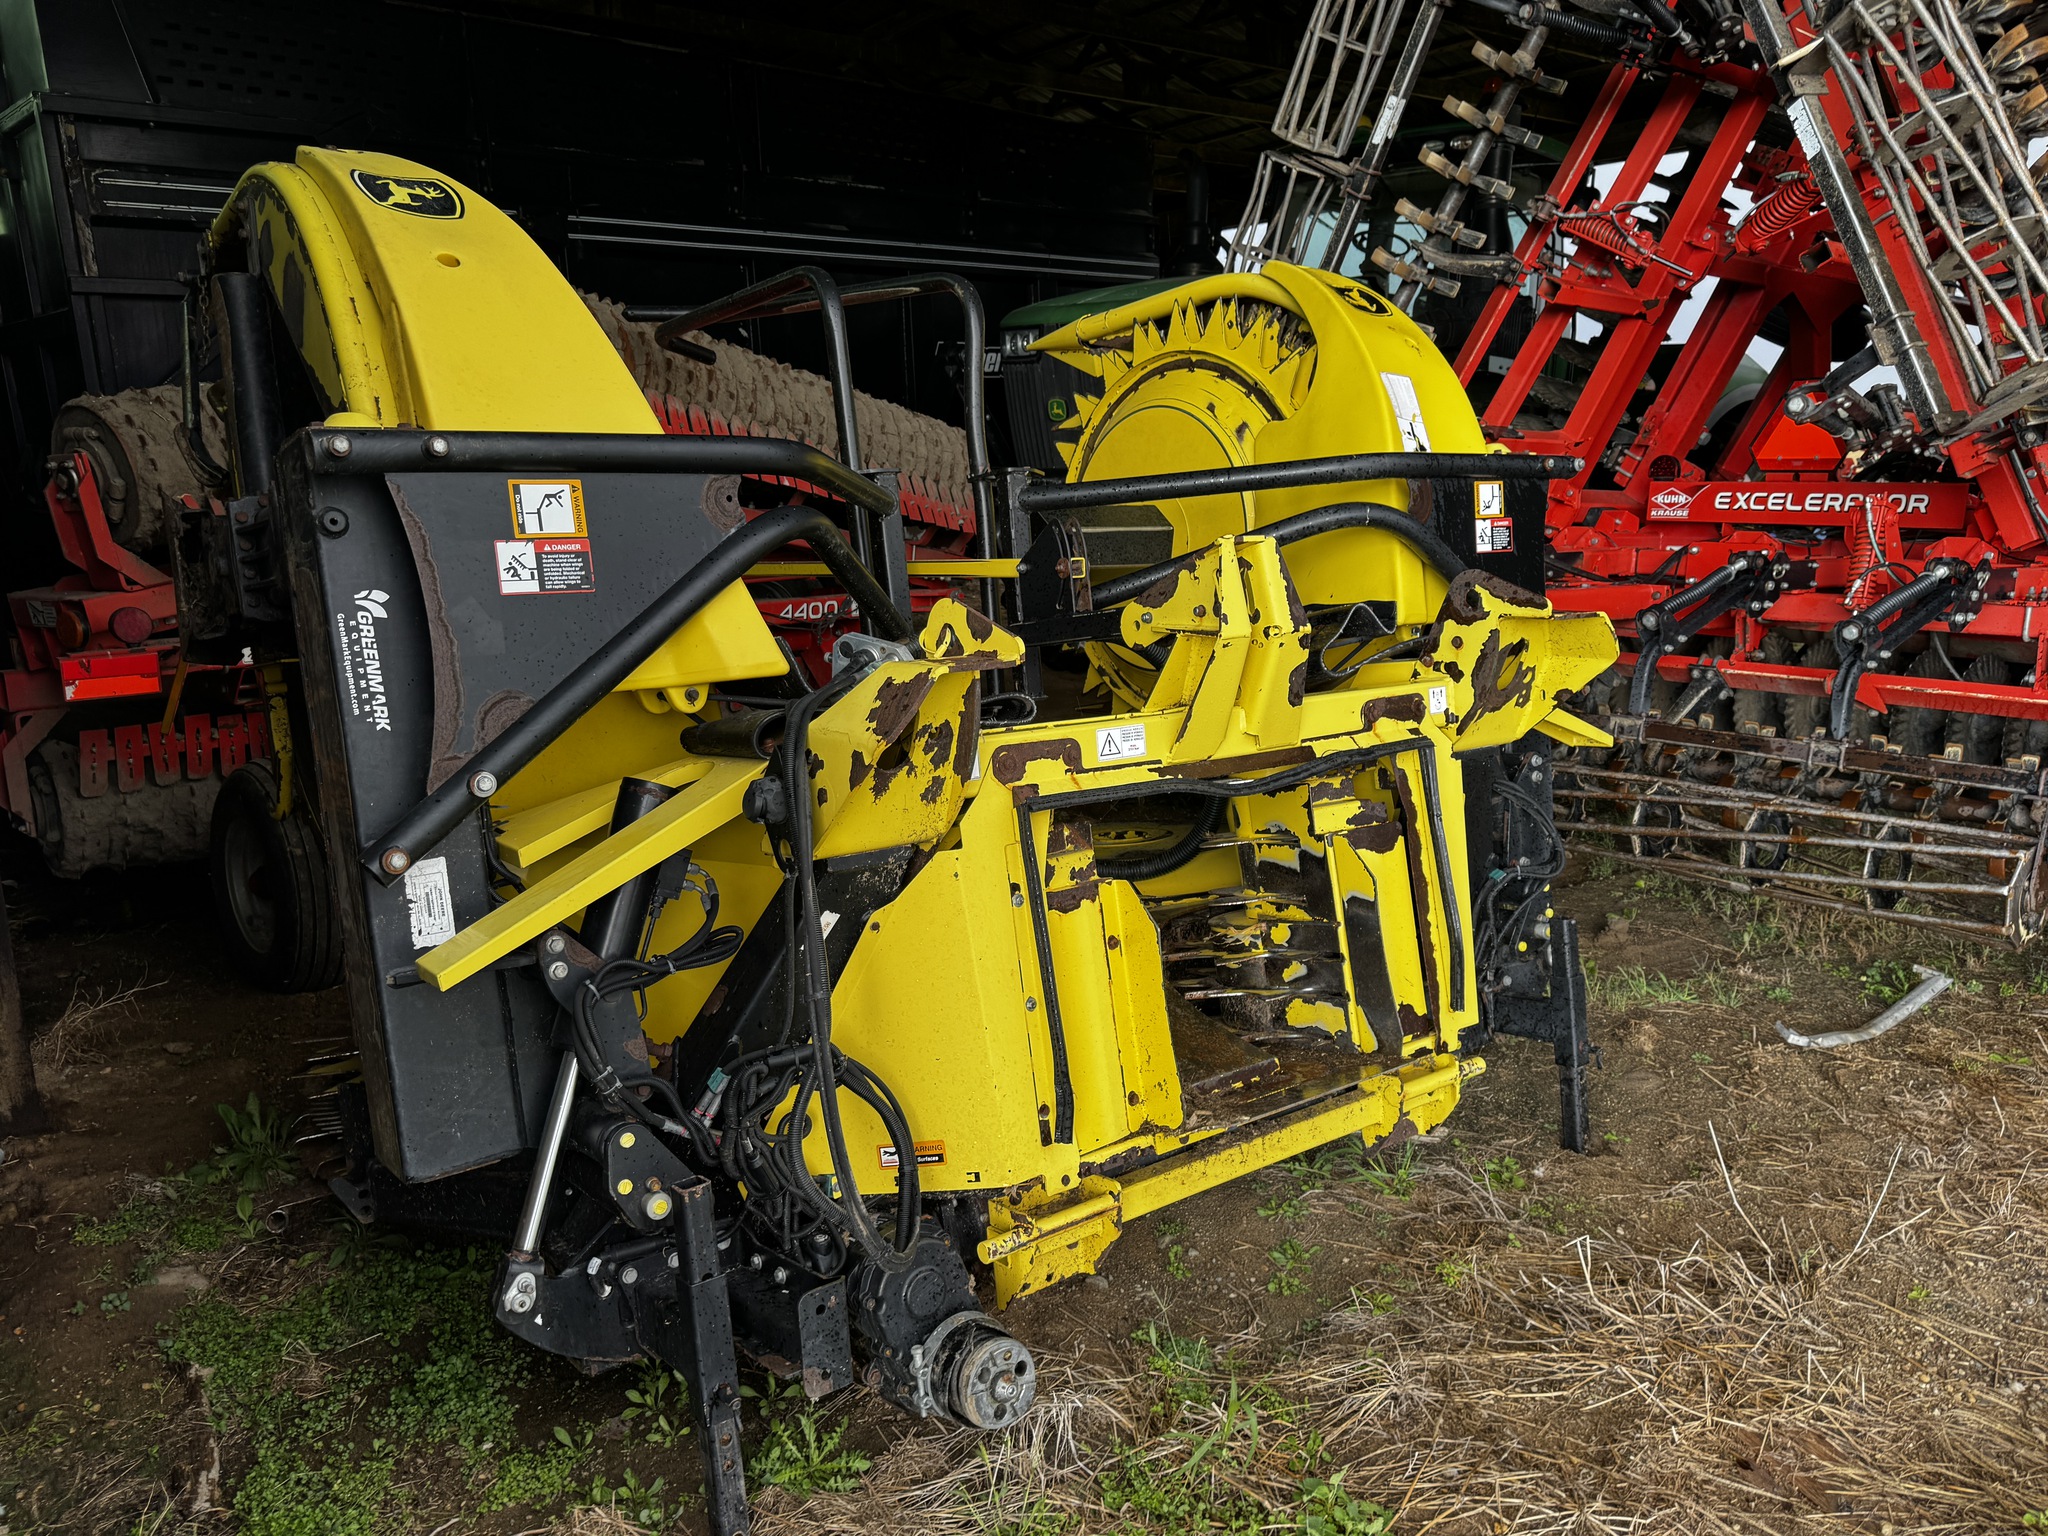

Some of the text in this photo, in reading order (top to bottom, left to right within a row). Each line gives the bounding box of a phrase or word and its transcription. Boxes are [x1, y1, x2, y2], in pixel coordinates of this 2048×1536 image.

[515, 494, 520, 502] Do
[1658, 495, 1686, 503] KUHN
[1714, 492, 1930, 514] EXCELERAOR
[574, 496, 584, 533] WARNING
[780, 601, 838, 620] 4400
[337, 613, 360, 716] GreenMarkEquipment.com
[350, 620, 373, 723] EQUIPMENT
[357, 611, 391, 732] GREENMARK
